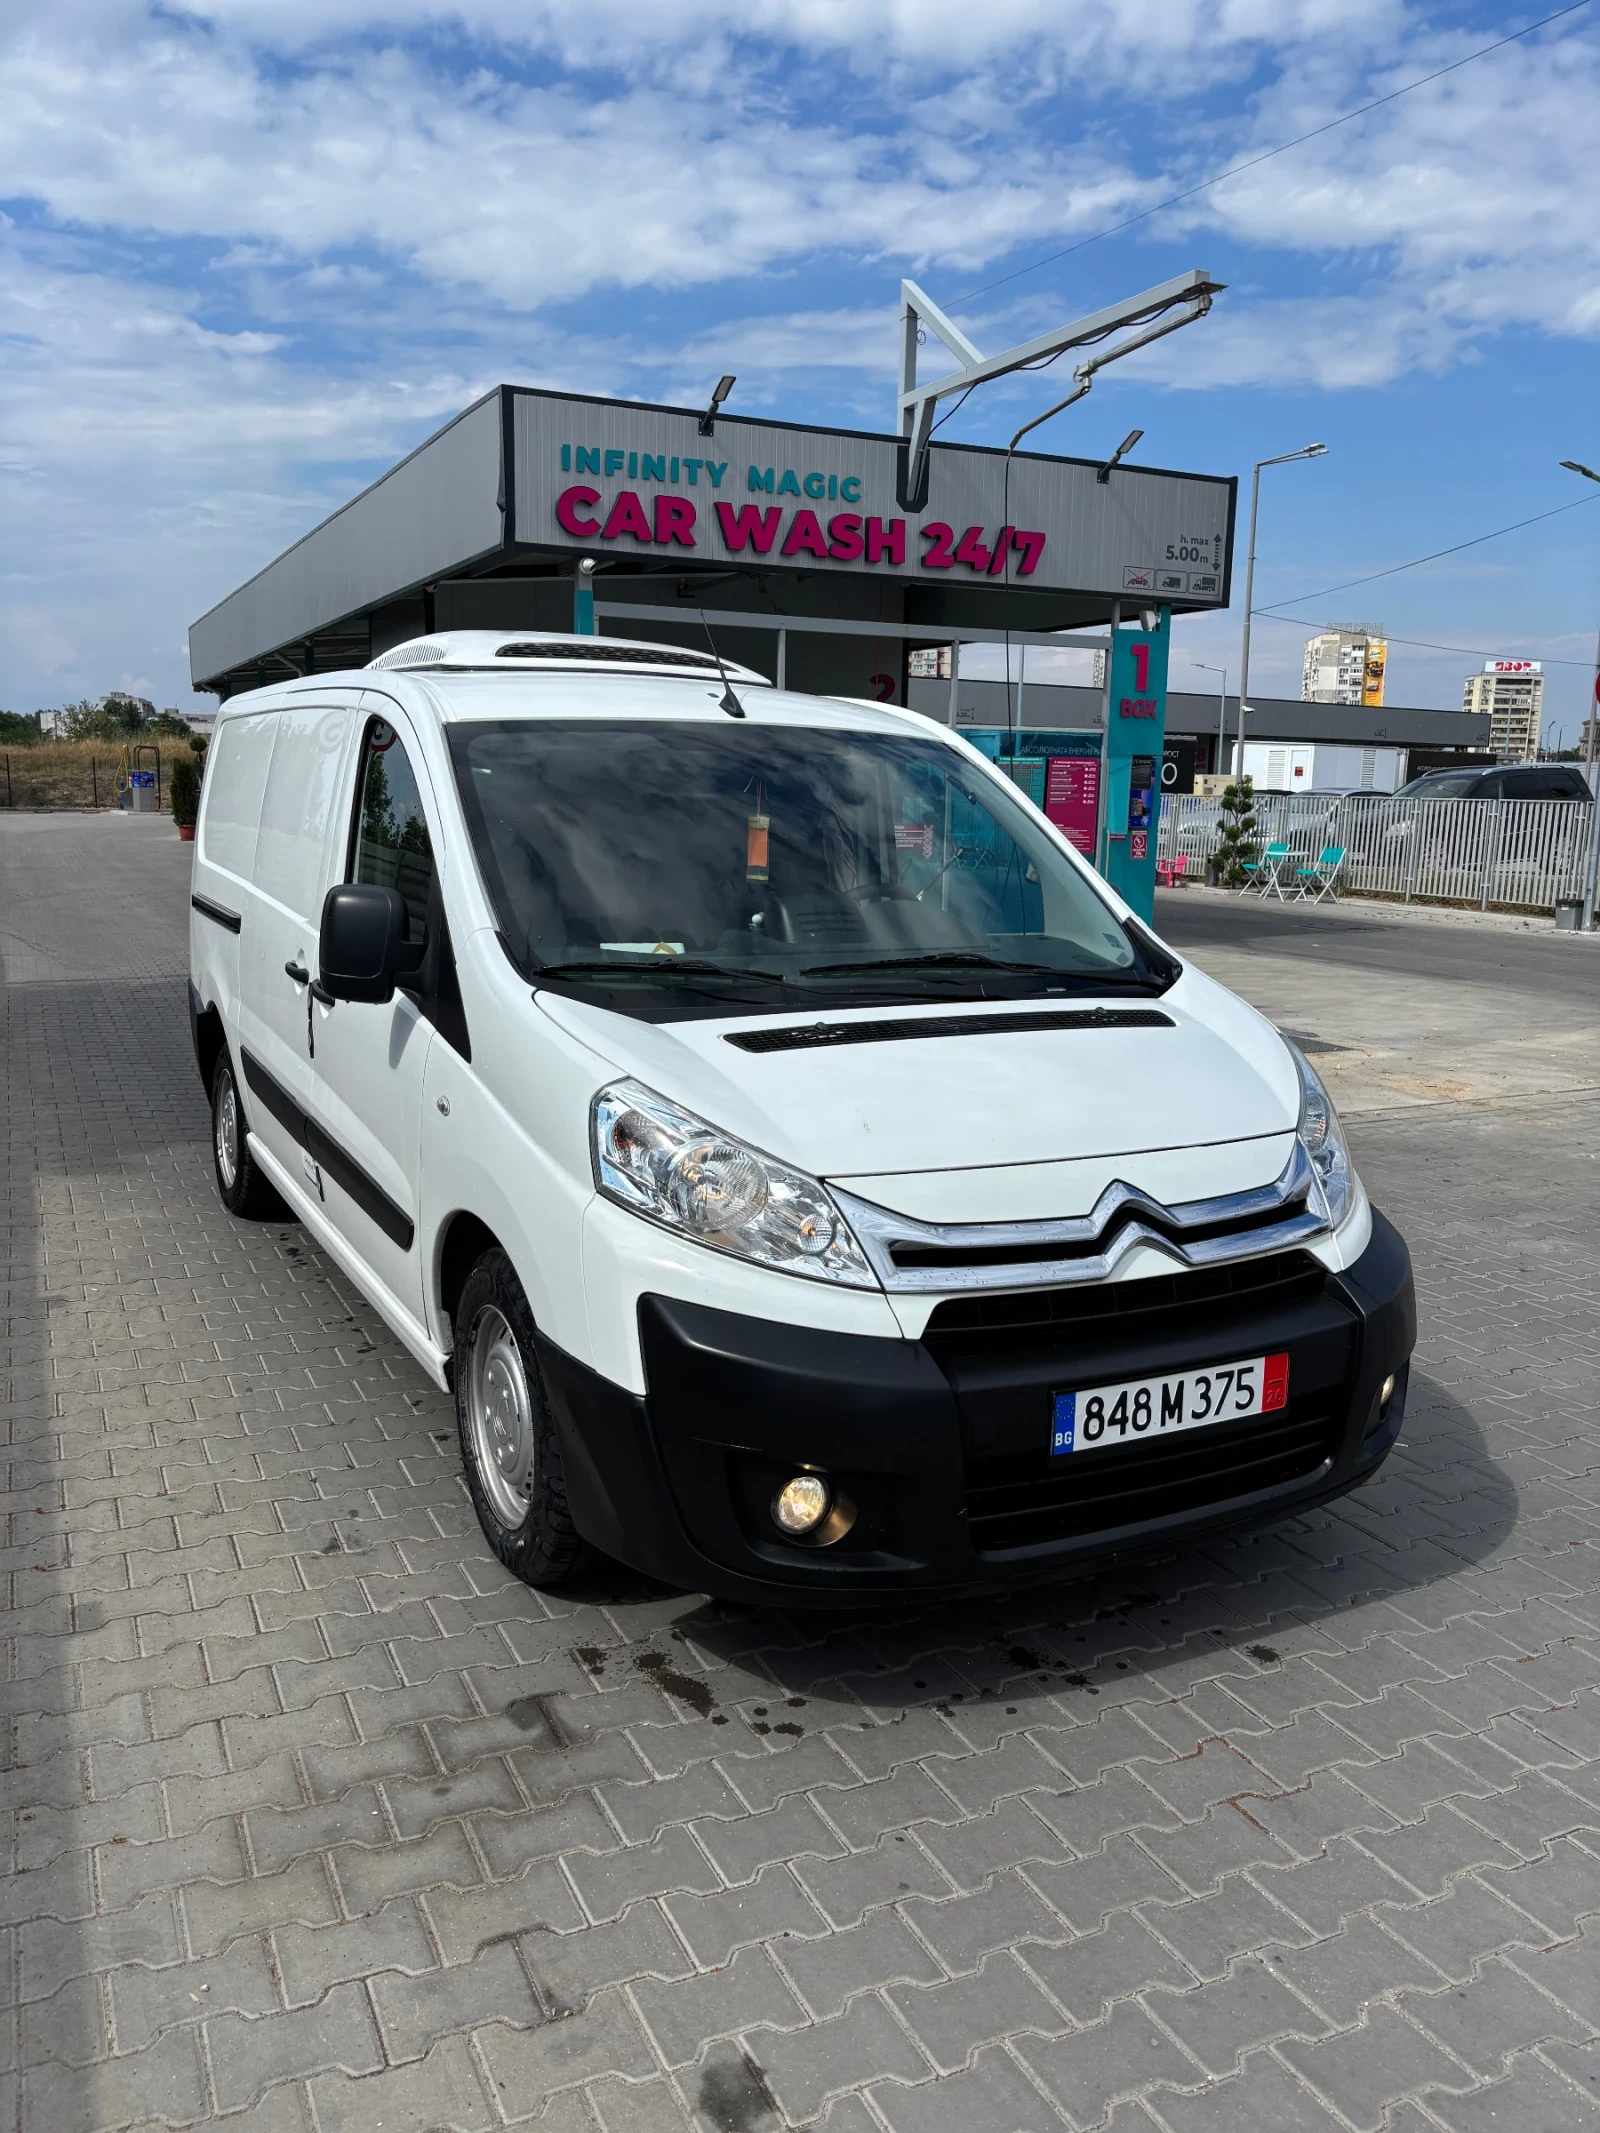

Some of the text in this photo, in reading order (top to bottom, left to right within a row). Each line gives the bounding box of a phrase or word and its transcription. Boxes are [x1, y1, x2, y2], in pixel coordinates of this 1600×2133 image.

[561, 443, 863, 503] INFINITY MAGIC
[556, 485, 1046, 575] CAR WASH 24/7
[1180, 535, 1209, 546] h. max
[1131, 644, 1150, 692] 1
[1120, 698, 1157, 719] BOX
[1021, 745, 1068, 755] АБСОЛЮТНАТА
[1055, 1431, 1073, 1447] BG
